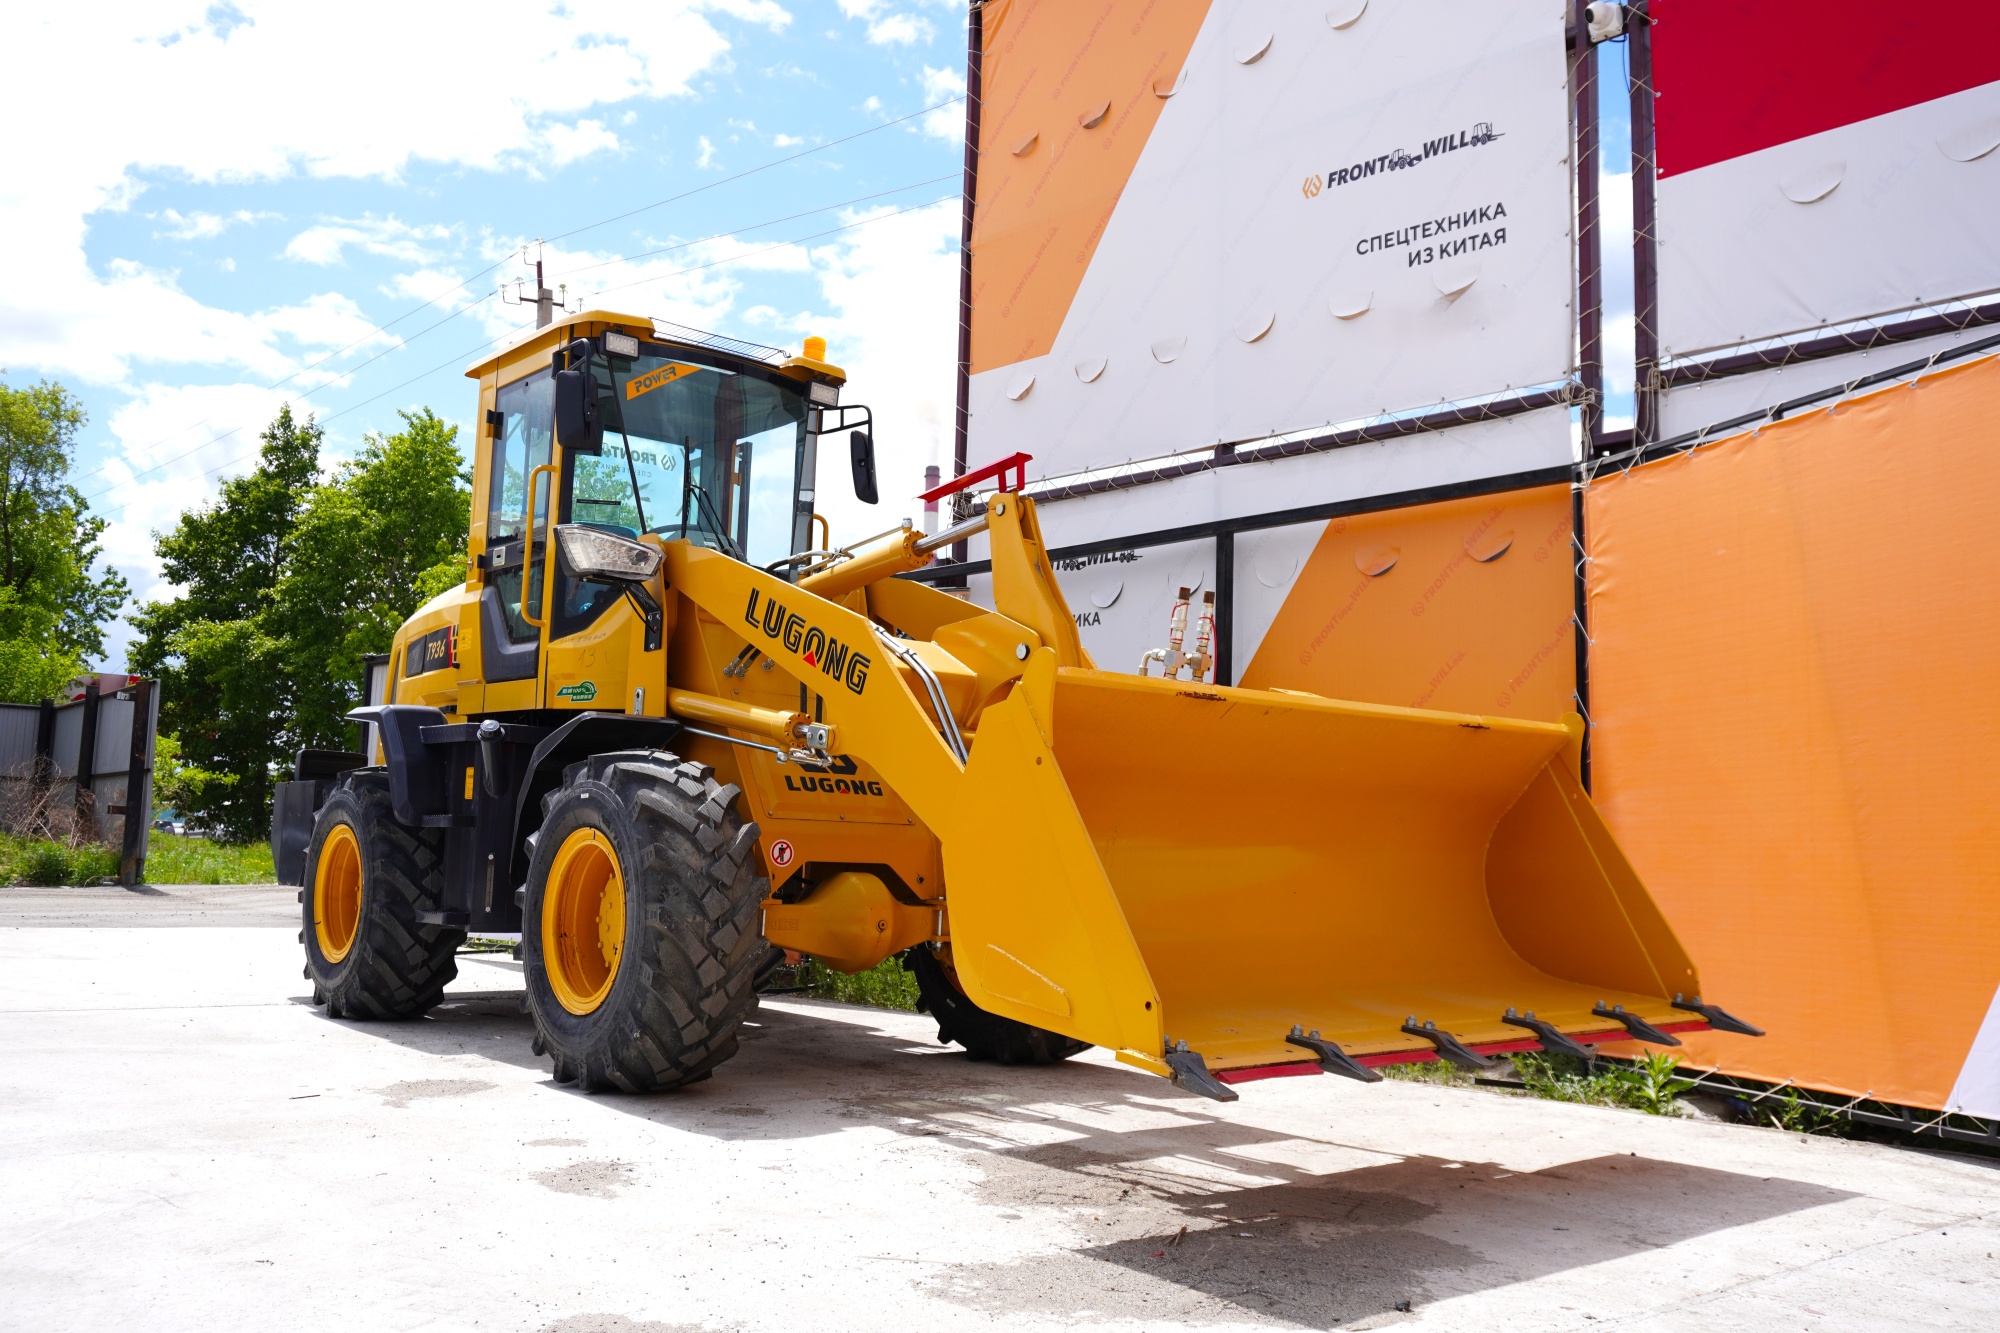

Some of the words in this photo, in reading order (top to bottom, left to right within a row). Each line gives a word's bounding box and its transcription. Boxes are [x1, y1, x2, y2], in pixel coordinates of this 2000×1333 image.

[1327, 154, 1390, 189] FRONT
[1423, 130, 1470, 159] WILL
[1356, 202, 1507, 255] СПЕЦТЕХНИКА
[1408, 246, 1434, 268] ИЗ
[1439, 227, 1507, 260] КИТАЯ
[633, 365, 677, 393] POWER
[427, 639, 446, 660] T936
[744, 587, 871, 695] LUGONG
[784, 775, 883, 797] LUGONG
